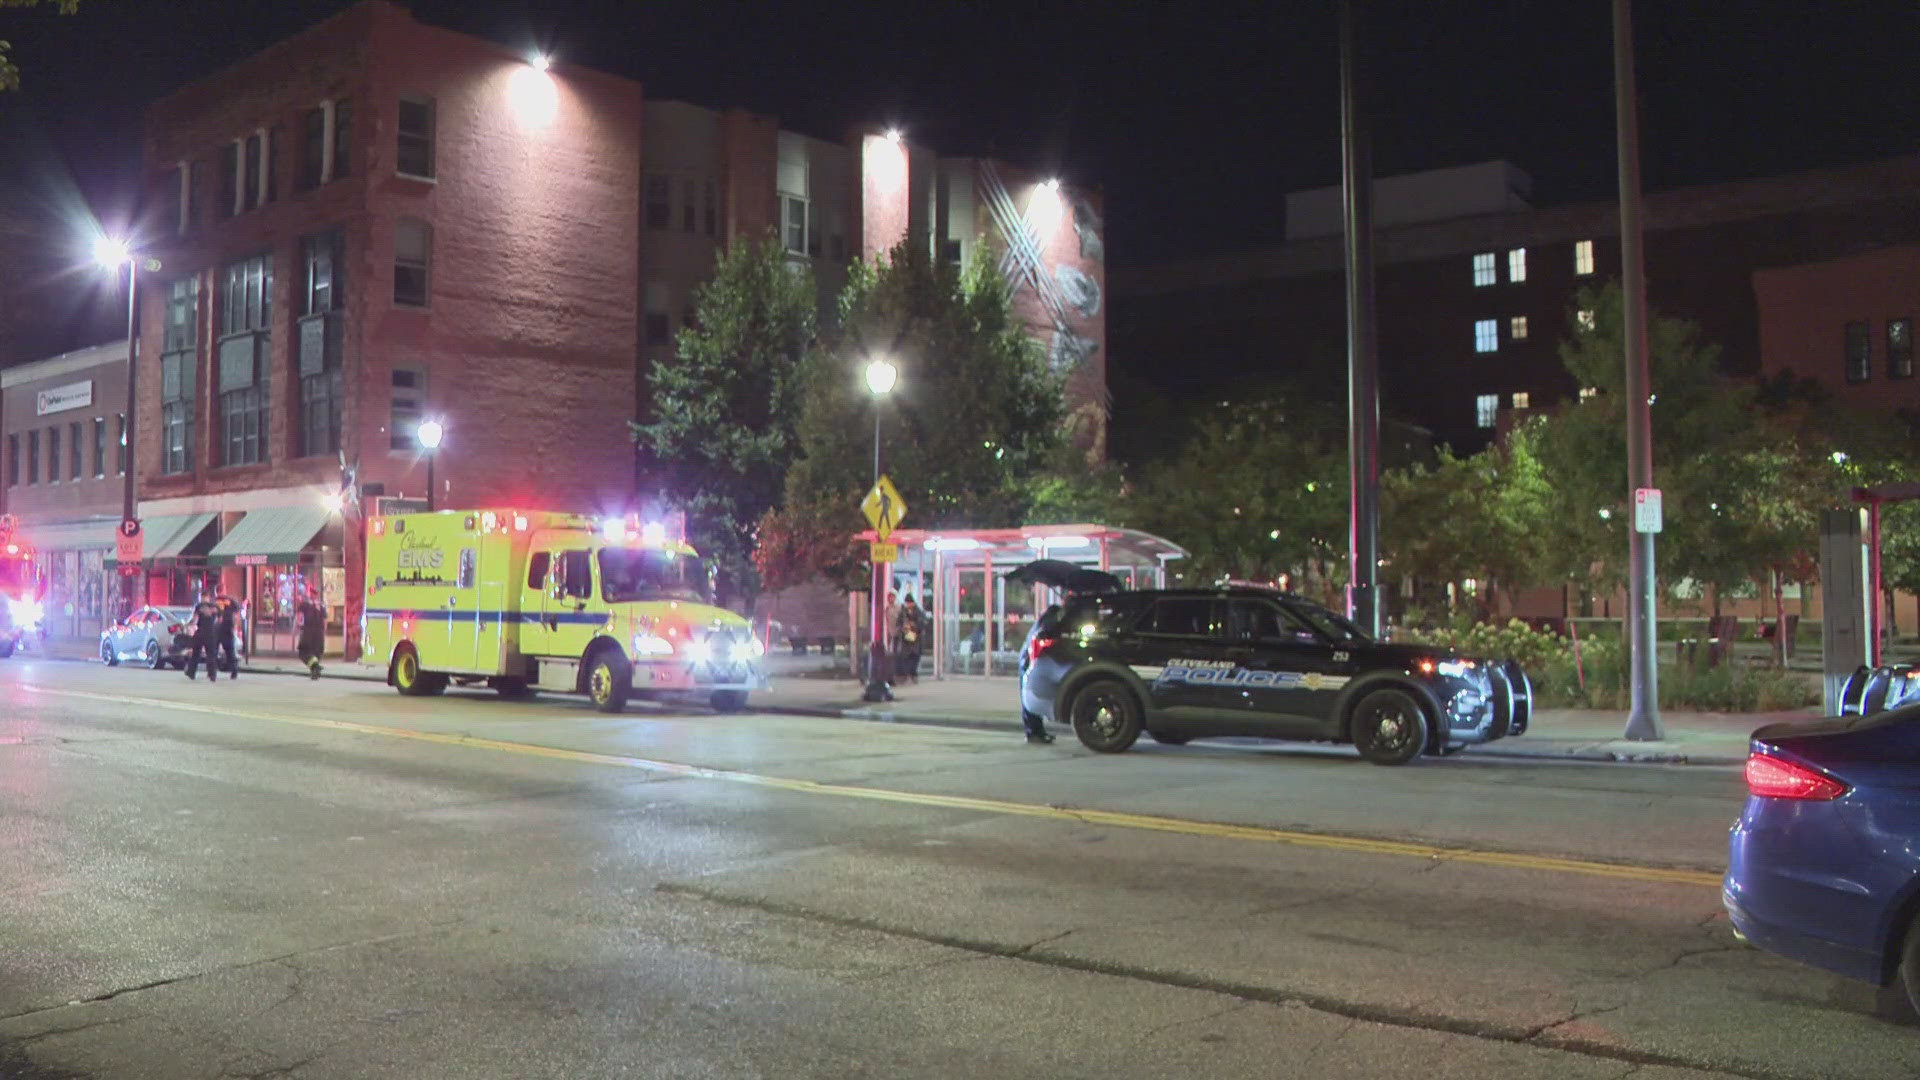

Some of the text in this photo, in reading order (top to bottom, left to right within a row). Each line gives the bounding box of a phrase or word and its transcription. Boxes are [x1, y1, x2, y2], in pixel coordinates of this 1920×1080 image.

[125, 521, 136, 535] P
[398, 550, 444, 569] EMS
[1167, 659, 1236, 669] CLEVELAND
[1159, 666, 1303, 689] POLICE
